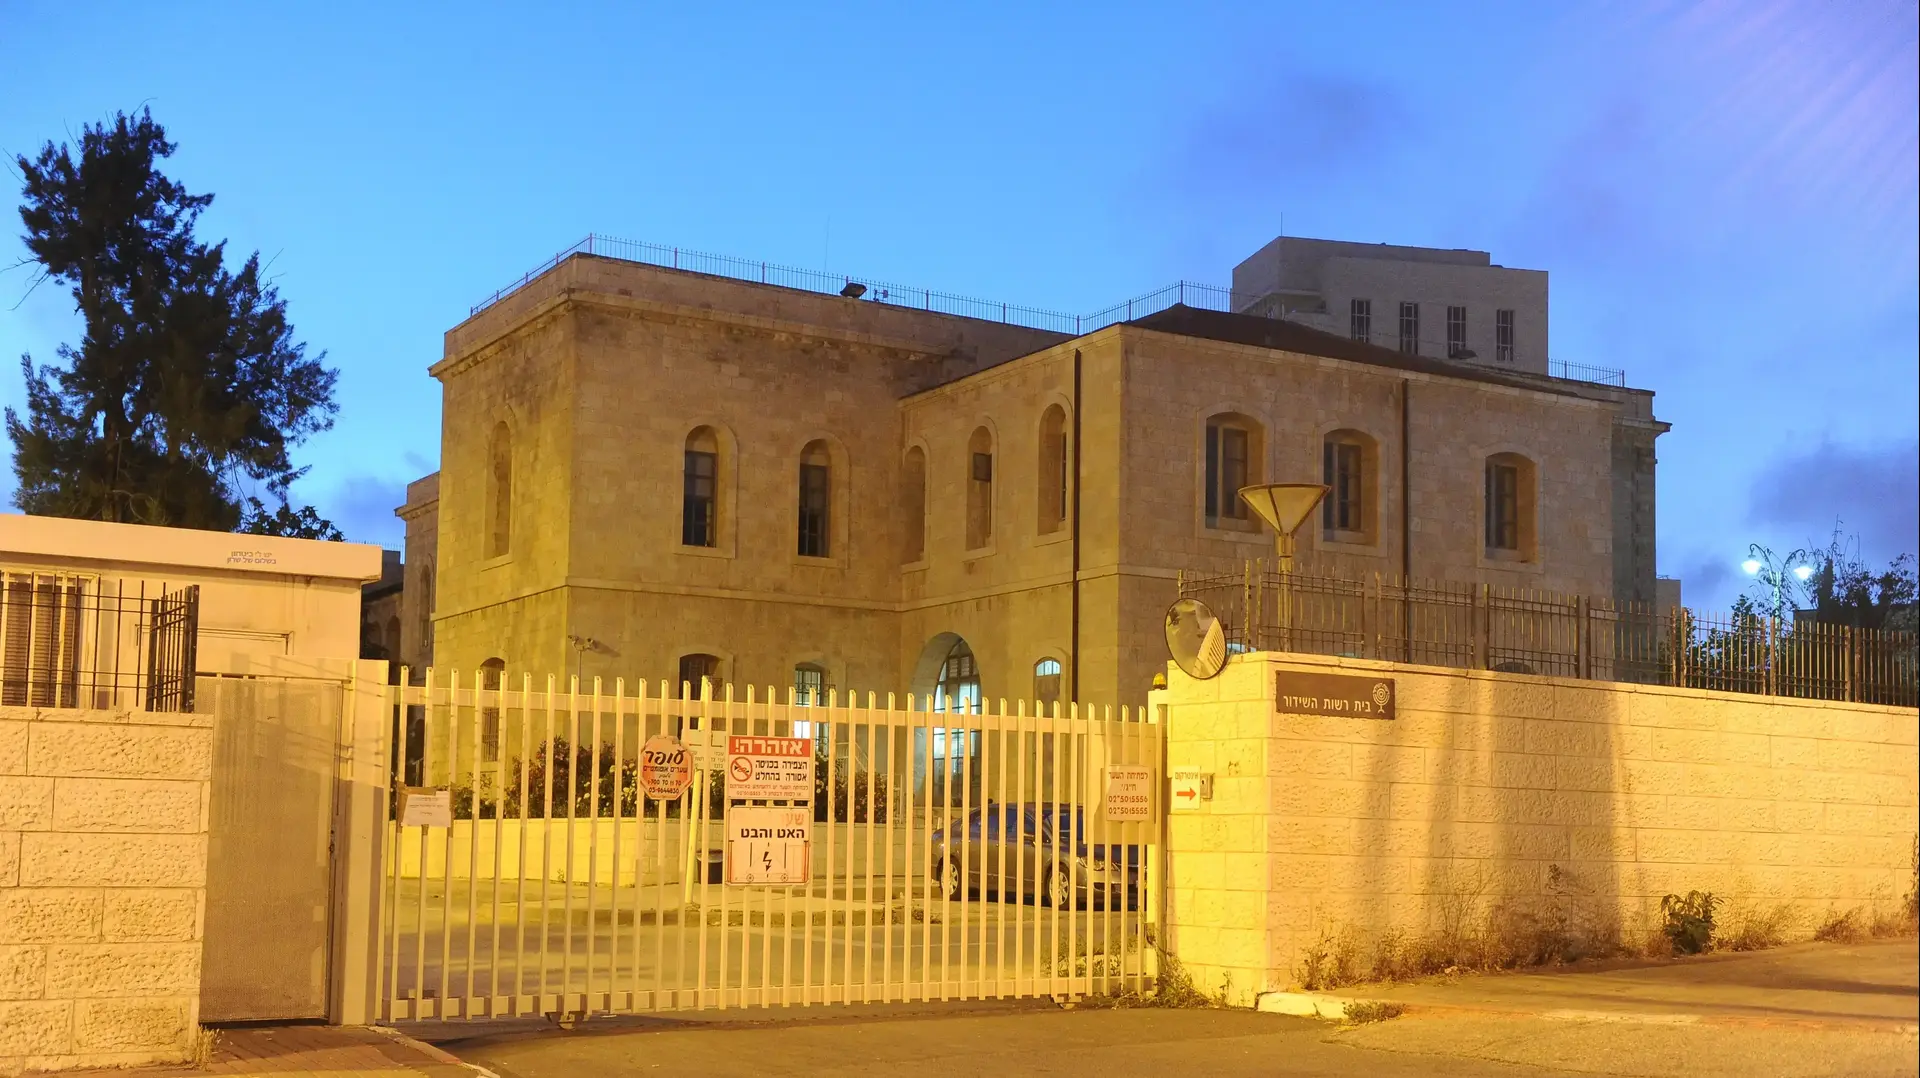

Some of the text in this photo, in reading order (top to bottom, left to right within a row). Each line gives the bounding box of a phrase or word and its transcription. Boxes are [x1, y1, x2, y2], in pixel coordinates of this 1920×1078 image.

[1284, 696, 1370, 712] בית רשות השידור
[736, 738, 802, 754] אזהרה!
[646, 750, 686, 764] עופר
[756, 760, 808, 770] הצפירה בכניסה
[756, 772, 808, 780] אסורה בהחלט
[740, 828, 804, 838] האט והבט
